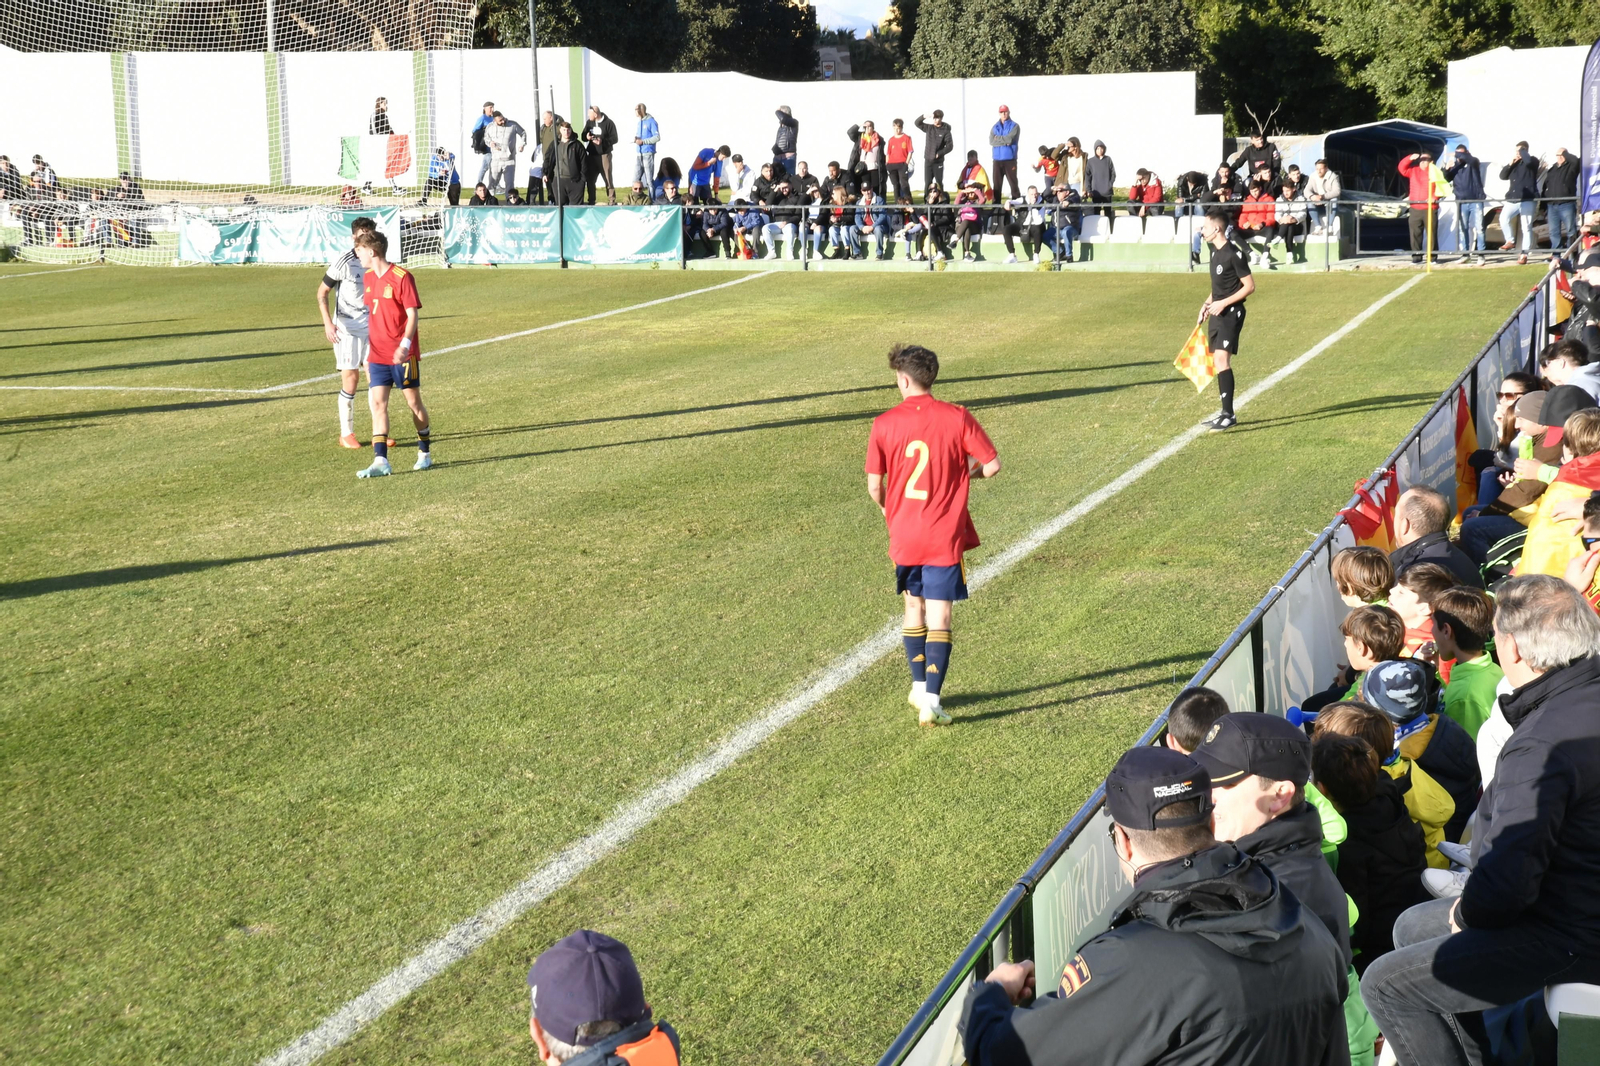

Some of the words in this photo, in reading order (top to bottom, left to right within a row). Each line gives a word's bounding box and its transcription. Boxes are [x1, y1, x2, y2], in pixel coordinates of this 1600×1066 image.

[1589, 121, 1597, 159] Diputación
[505, 213, 527, 222] PACO
[372, 298, 379, 315] 7
[402, 362, 410, 378] 7
[904, 439, 930, 501] 2
[1153, 782, 1185, 792] POLICIA
[1154, 785, 1193, 798] NACIONAL
